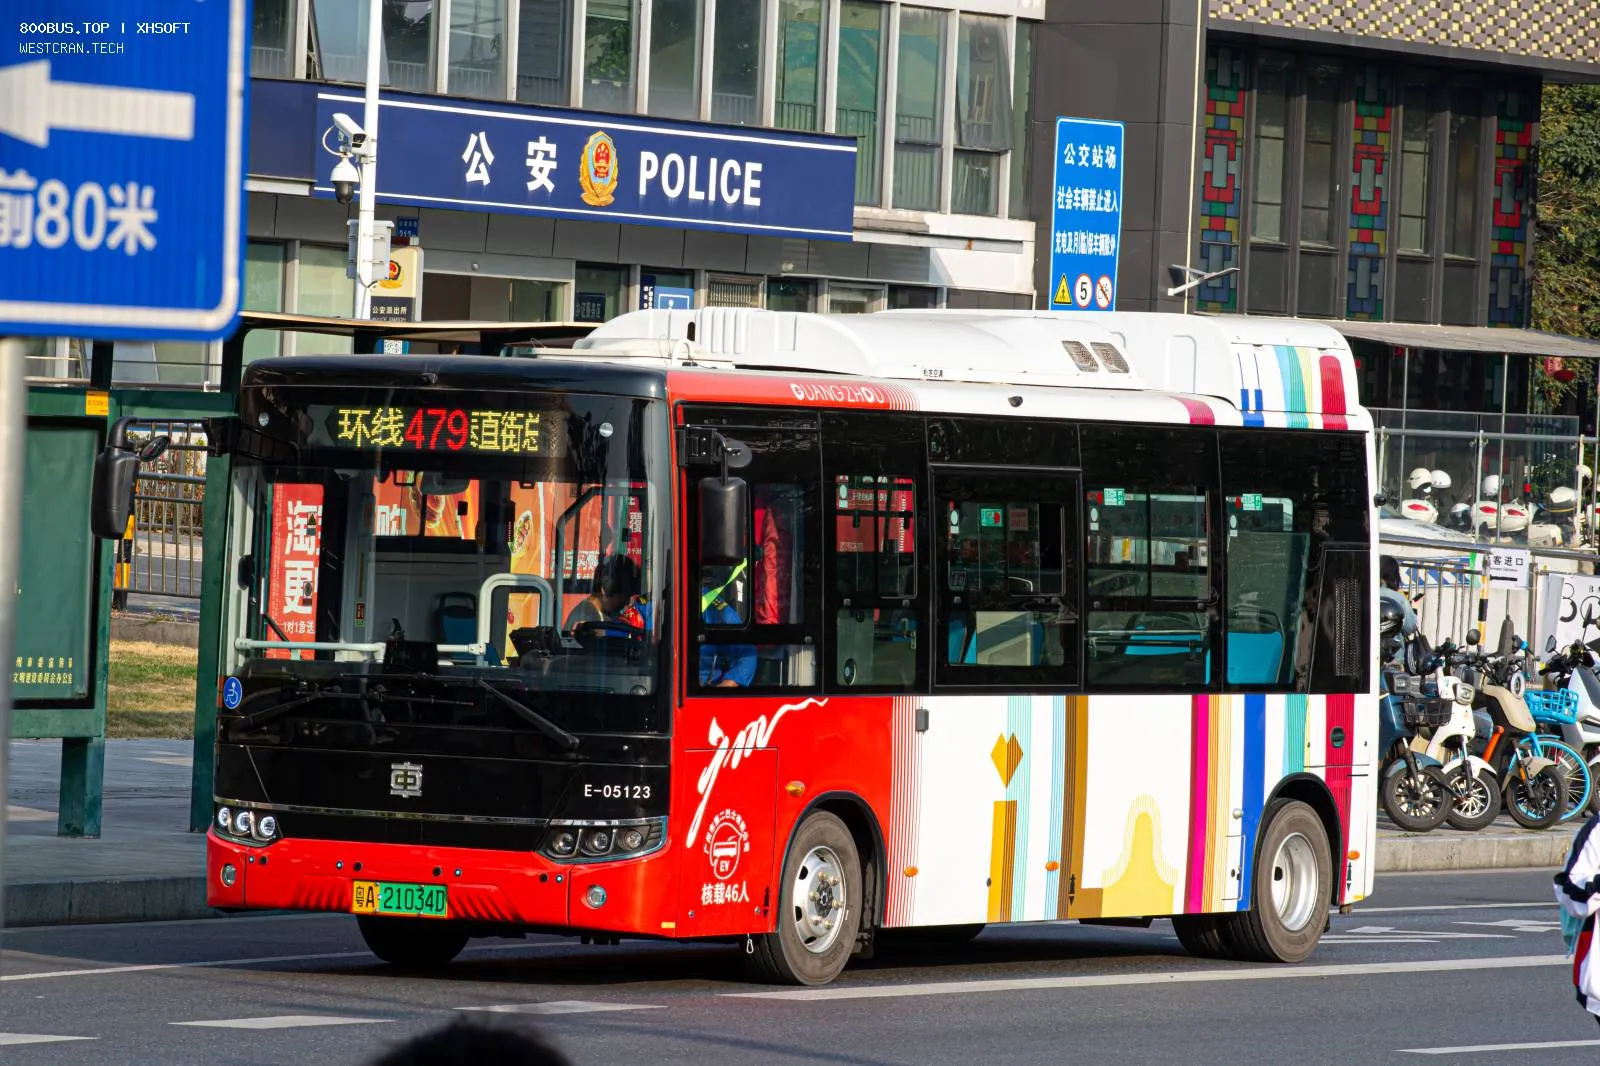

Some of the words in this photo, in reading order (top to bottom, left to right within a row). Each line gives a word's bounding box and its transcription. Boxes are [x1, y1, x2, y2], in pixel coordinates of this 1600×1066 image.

[1063, 143, 1117, 169] 公交站场
[462, 131, 557, 193] 公安
[639, 150, 763, 207] POLICE
[1057, 185, 1119, 213] 社会车辆禁止进入
[1079, 281, 1087, 300] 5
[790, 383, 885, 404] GUANGZHOU
[583, 784, 651, 800] E-05123
[719, 860, 730, 872] EV
[701, 881, 750, 906] 核载46人
